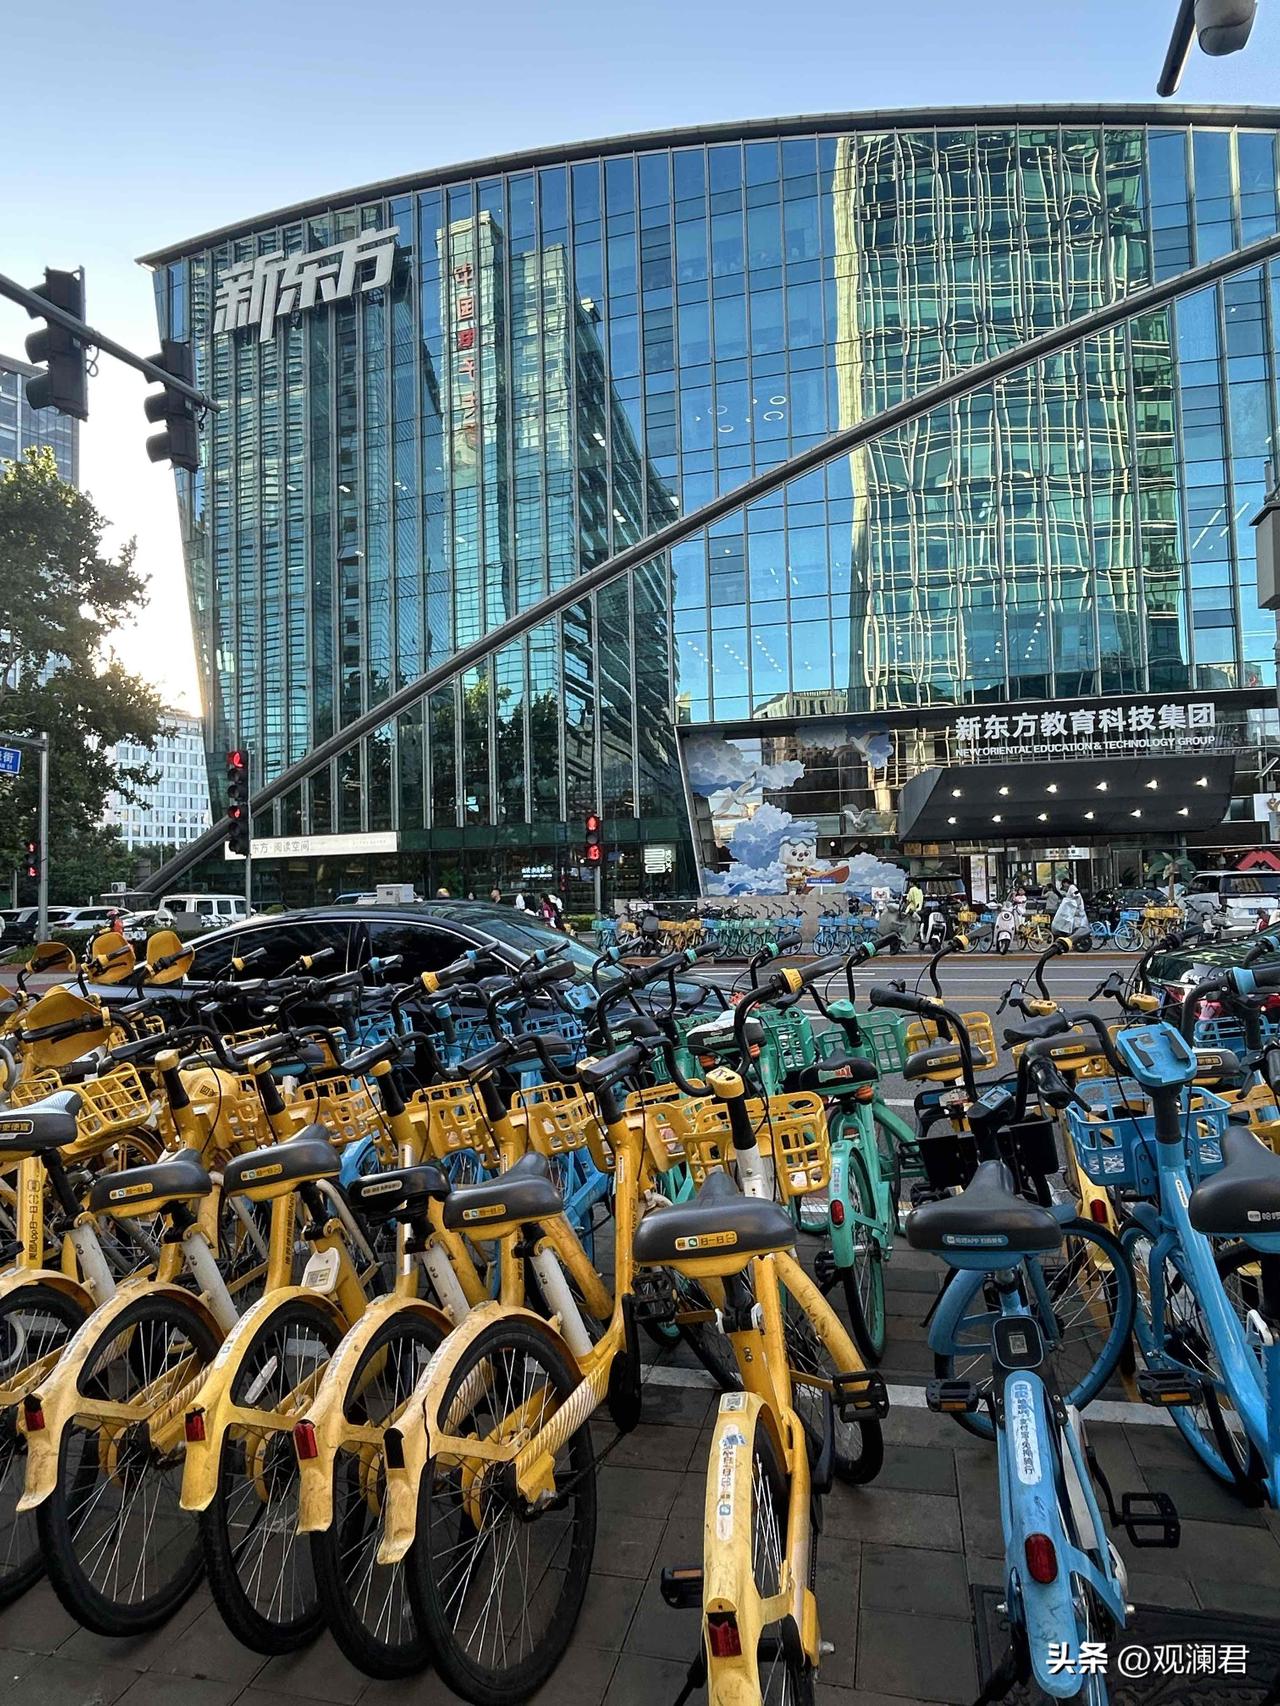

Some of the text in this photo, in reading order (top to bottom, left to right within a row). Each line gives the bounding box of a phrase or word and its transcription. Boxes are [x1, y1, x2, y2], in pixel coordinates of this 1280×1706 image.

[213, 226, 400, 342] 新东方
[955, 702, 1216, 741] 新东方教育科技集团
[955, 735, 1216, 757] NEW ORIENTAL EDUCATION & TECHNOLOGY GROUP
